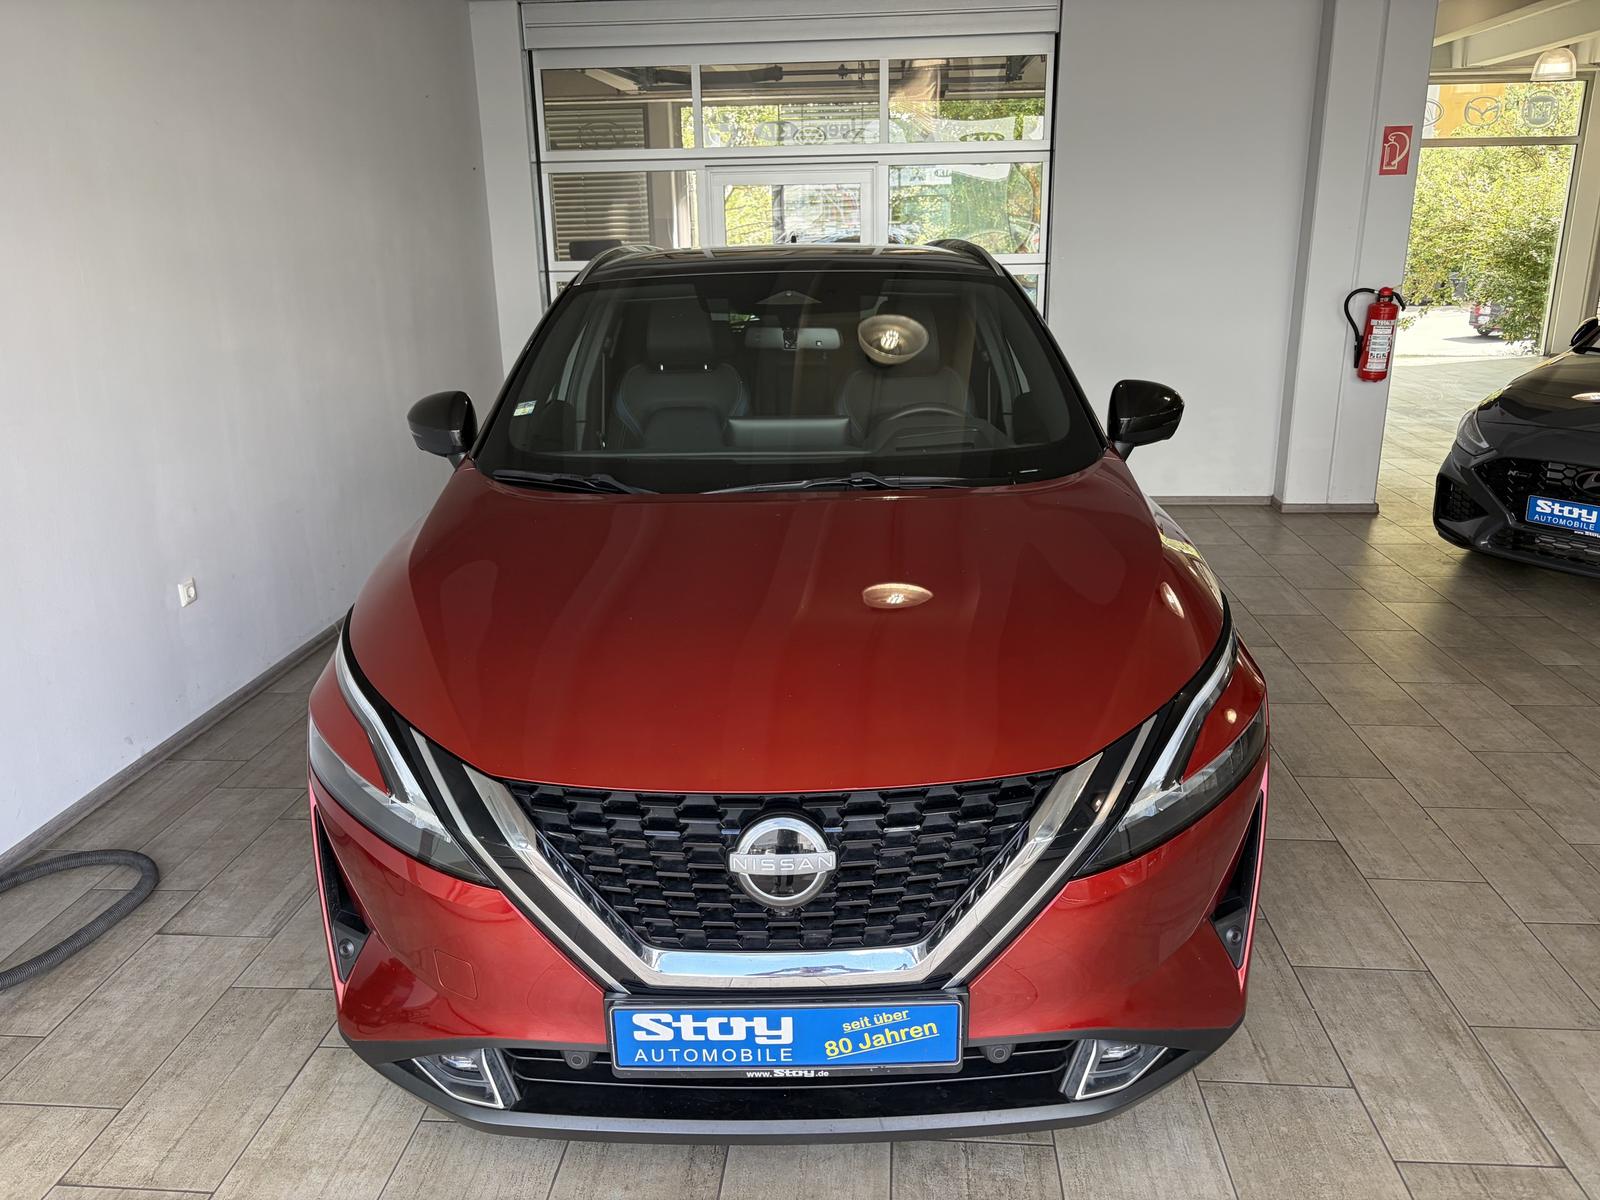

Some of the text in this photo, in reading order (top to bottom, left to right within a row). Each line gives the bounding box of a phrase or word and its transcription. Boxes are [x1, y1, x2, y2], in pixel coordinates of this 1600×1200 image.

[1533, 514, 1596, 531] AUTOMOBILE
[1535, 499, 1598, 523] Stoy
[733, 854, 833, 871] NISSAN
[632, 1013, 794, 1045] Stoy
[842, 1009, 909, 1032] seit über
[824, 1022, 938, 1057] 80 Jahren
[634, 1048, 793, 1063] AUTOMOBILE
